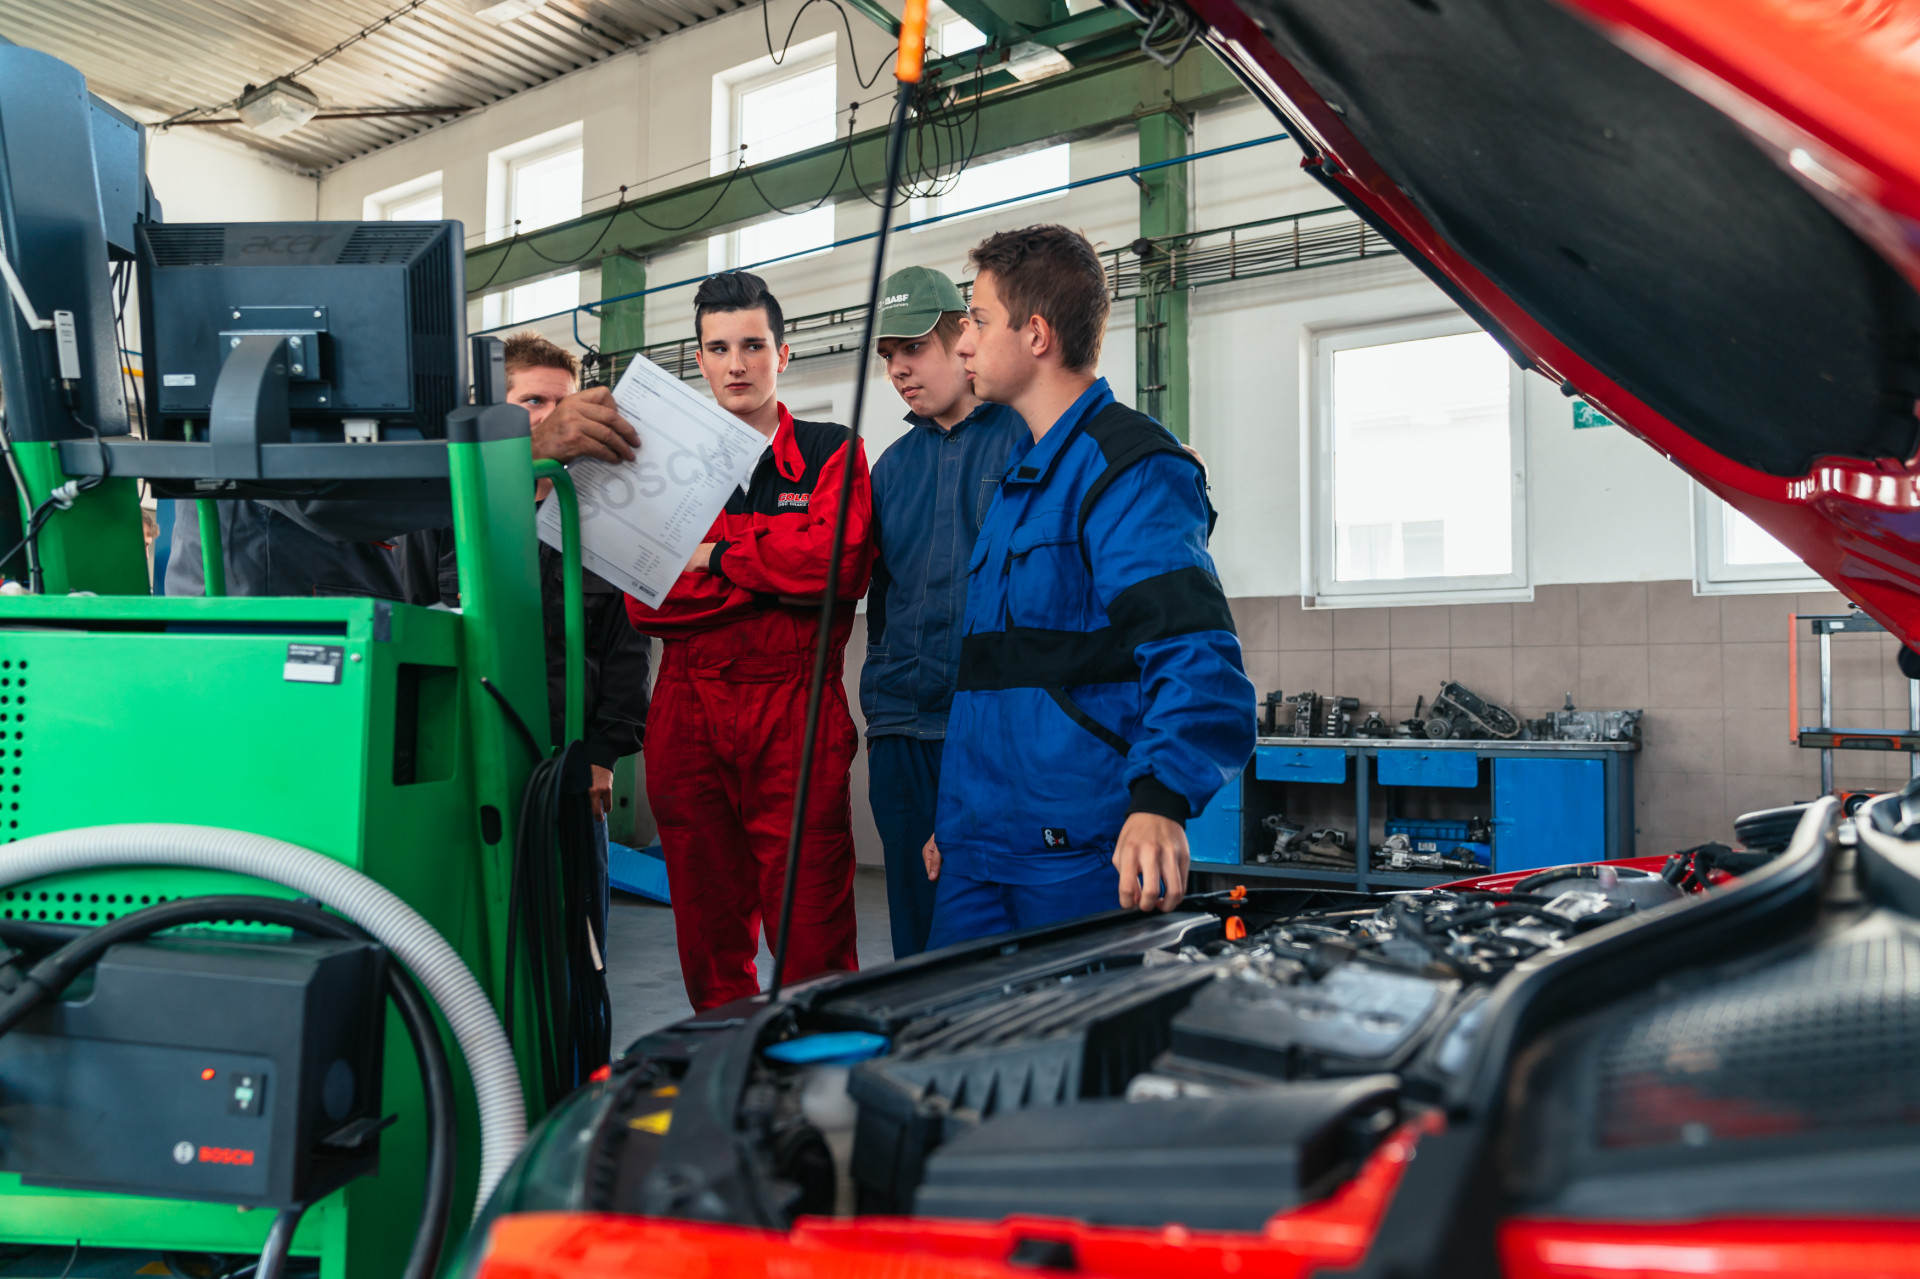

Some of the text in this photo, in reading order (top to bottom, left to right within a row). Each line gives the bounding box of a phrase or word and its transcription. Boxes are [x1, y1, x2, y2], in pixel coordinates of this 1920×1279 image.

[241, 235, 334, 254] acer
[885, 293, 909, 305] BASF
[778, 493, 812, 502] GOLD
[198, 1146, 254, 1166] BOSCH
